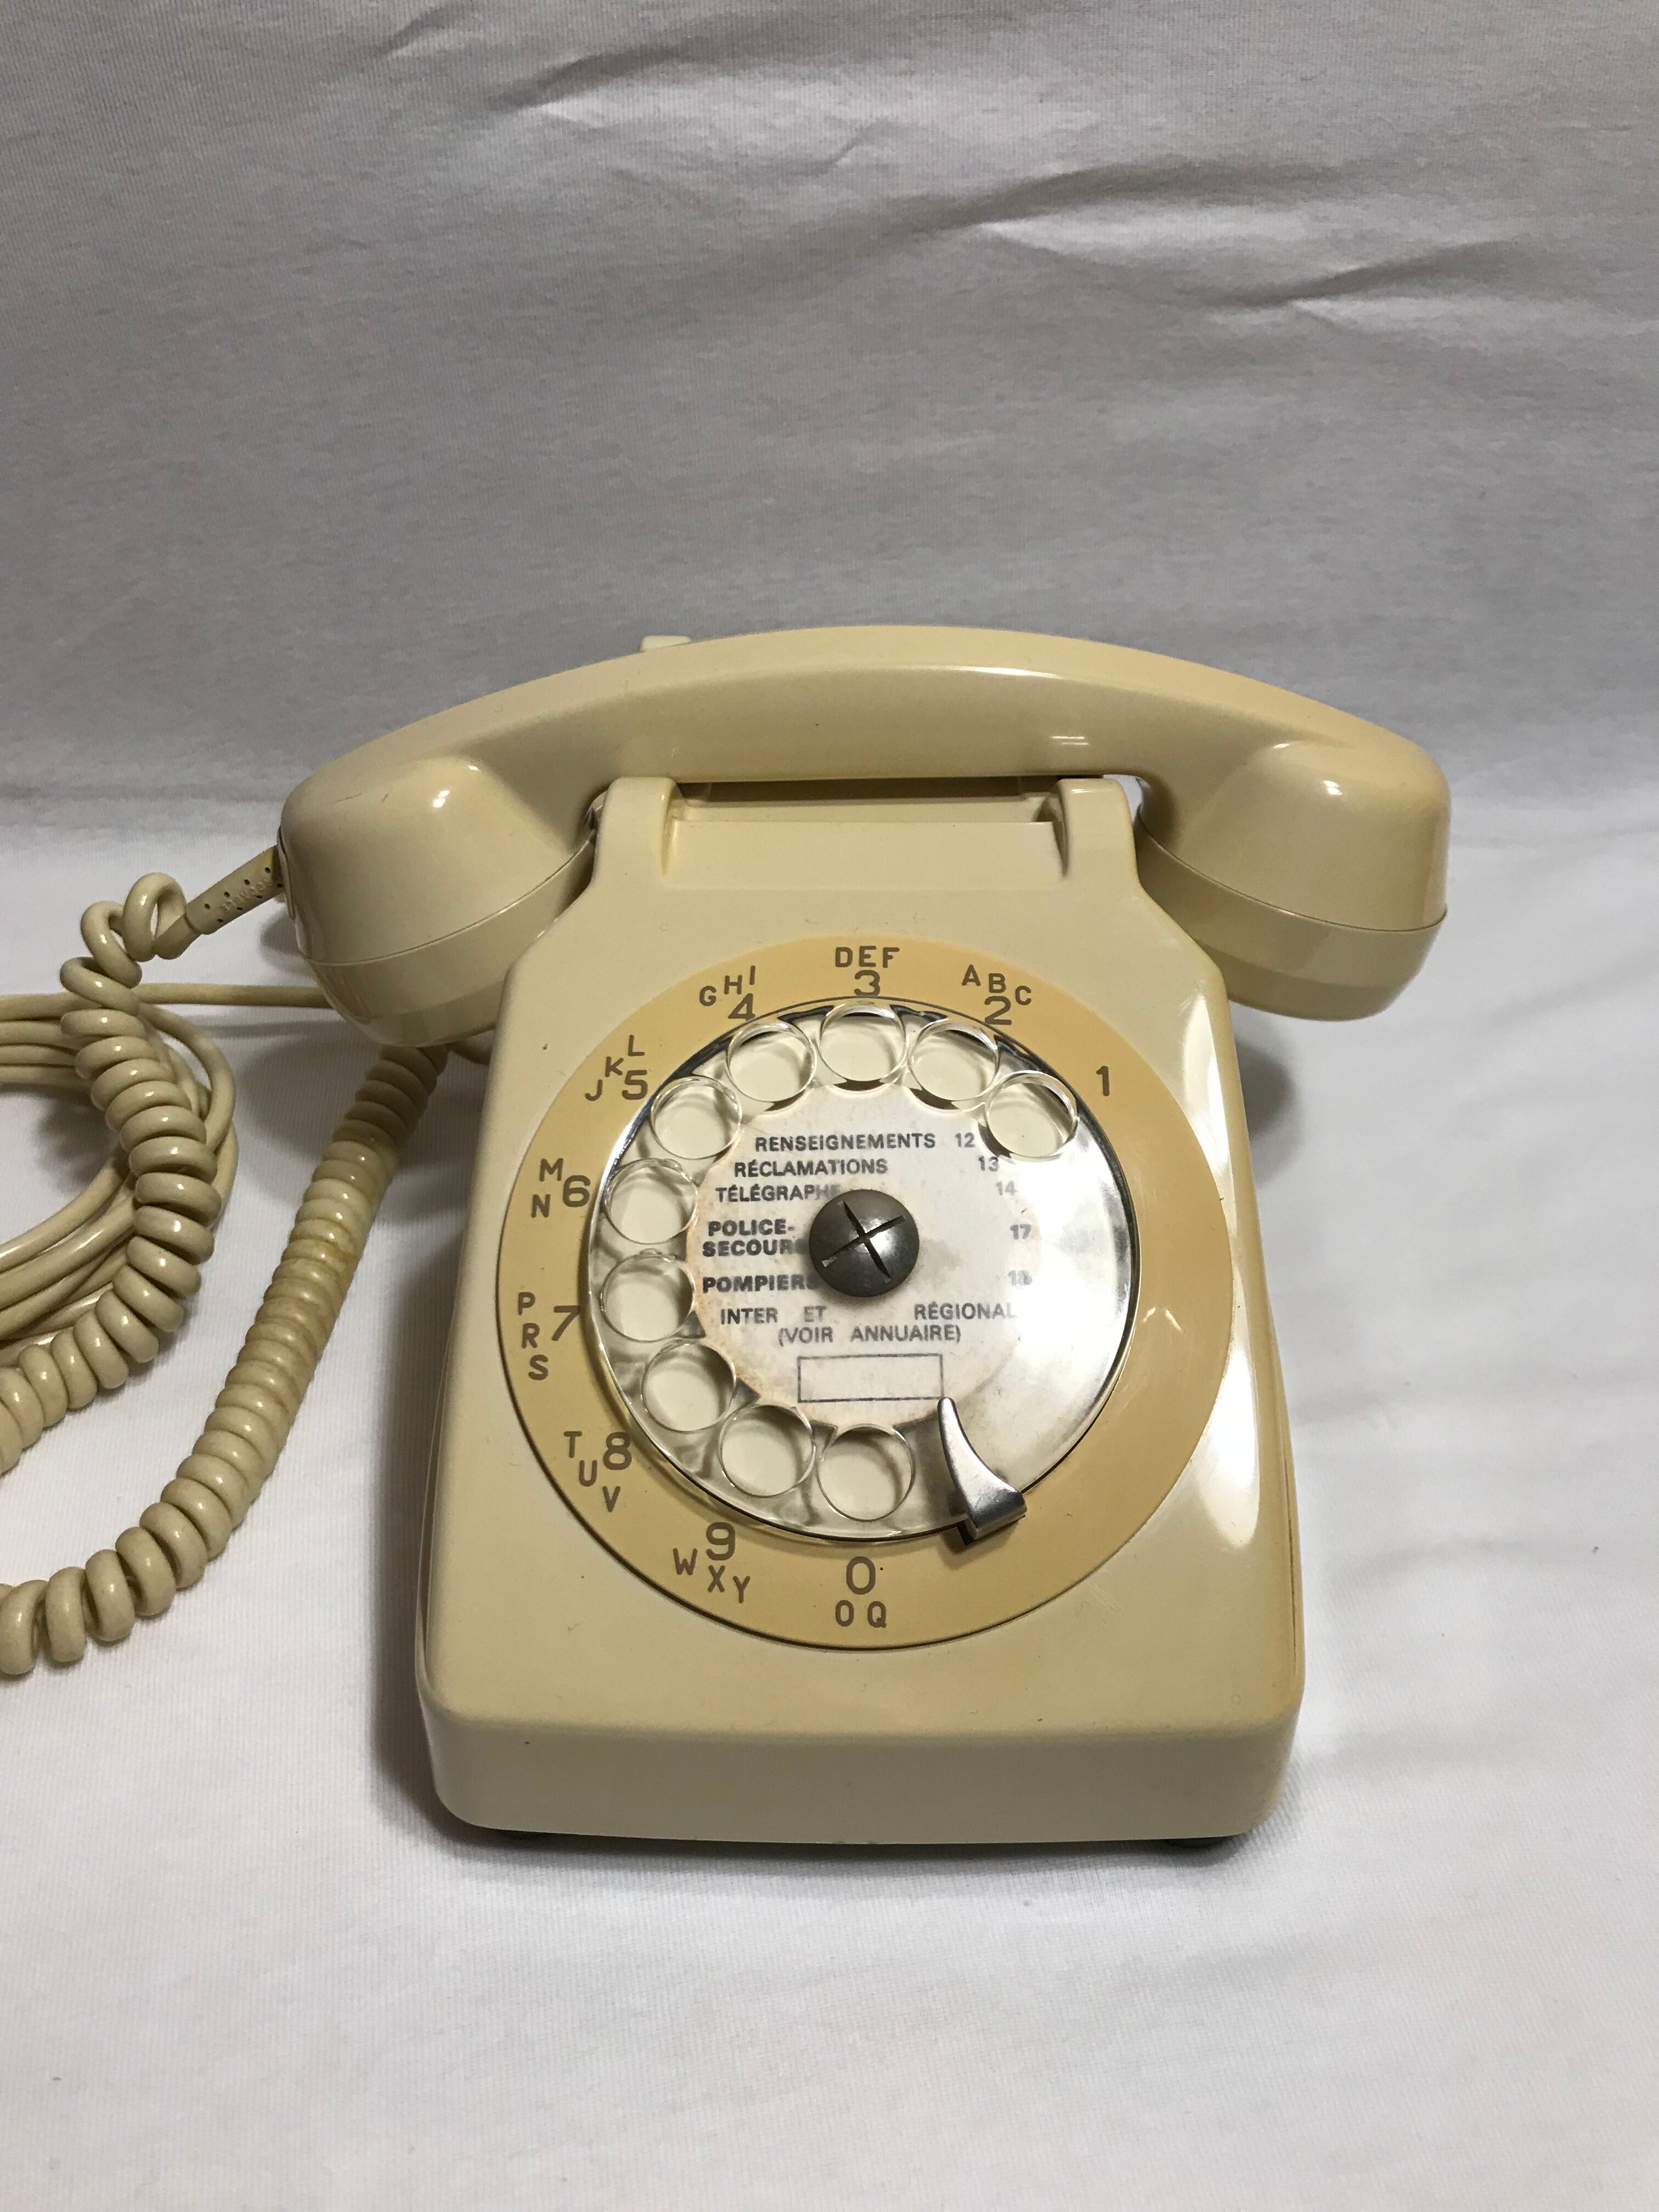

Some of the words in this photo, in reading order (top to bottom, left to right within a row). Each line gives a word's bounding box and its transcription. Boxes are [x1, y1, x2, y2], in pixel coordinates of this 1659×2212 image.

[835, 945, 900, 968] DEF
[854, 969, 881, 997] 3
[727, 993, 755, 1020] 4
[984, 995, 1013, 1025] 2
[622, 1069, 648, 1100] 5
[1096, 1065, 1110, 1096] 1
[755, 1132, 936, 1152] RENSEIGNEMENTS
[955, 1132, 975, 1148] 12
[734, 1158, 889, 1177] RÉCLAMATIONS
[978, 1156, 999, 1172] 13
[563, 1175, 591, 1207] 6
[996, 1180, 1017, 1197] 14
[1010, 1224, 1032, 1240] 17
[551, 1305, 580, 1341] 7
[720, 1307, 778, 1325] INTER
[804, 1305, 827, 1323] ET
[778, 1327, 834, 1347] (VOIR
[850, 1324, 961, 1344] ANNUAIRE)
[603, 1431, 633, 1470] 8
[706, 1521, 736, 1561] 9
